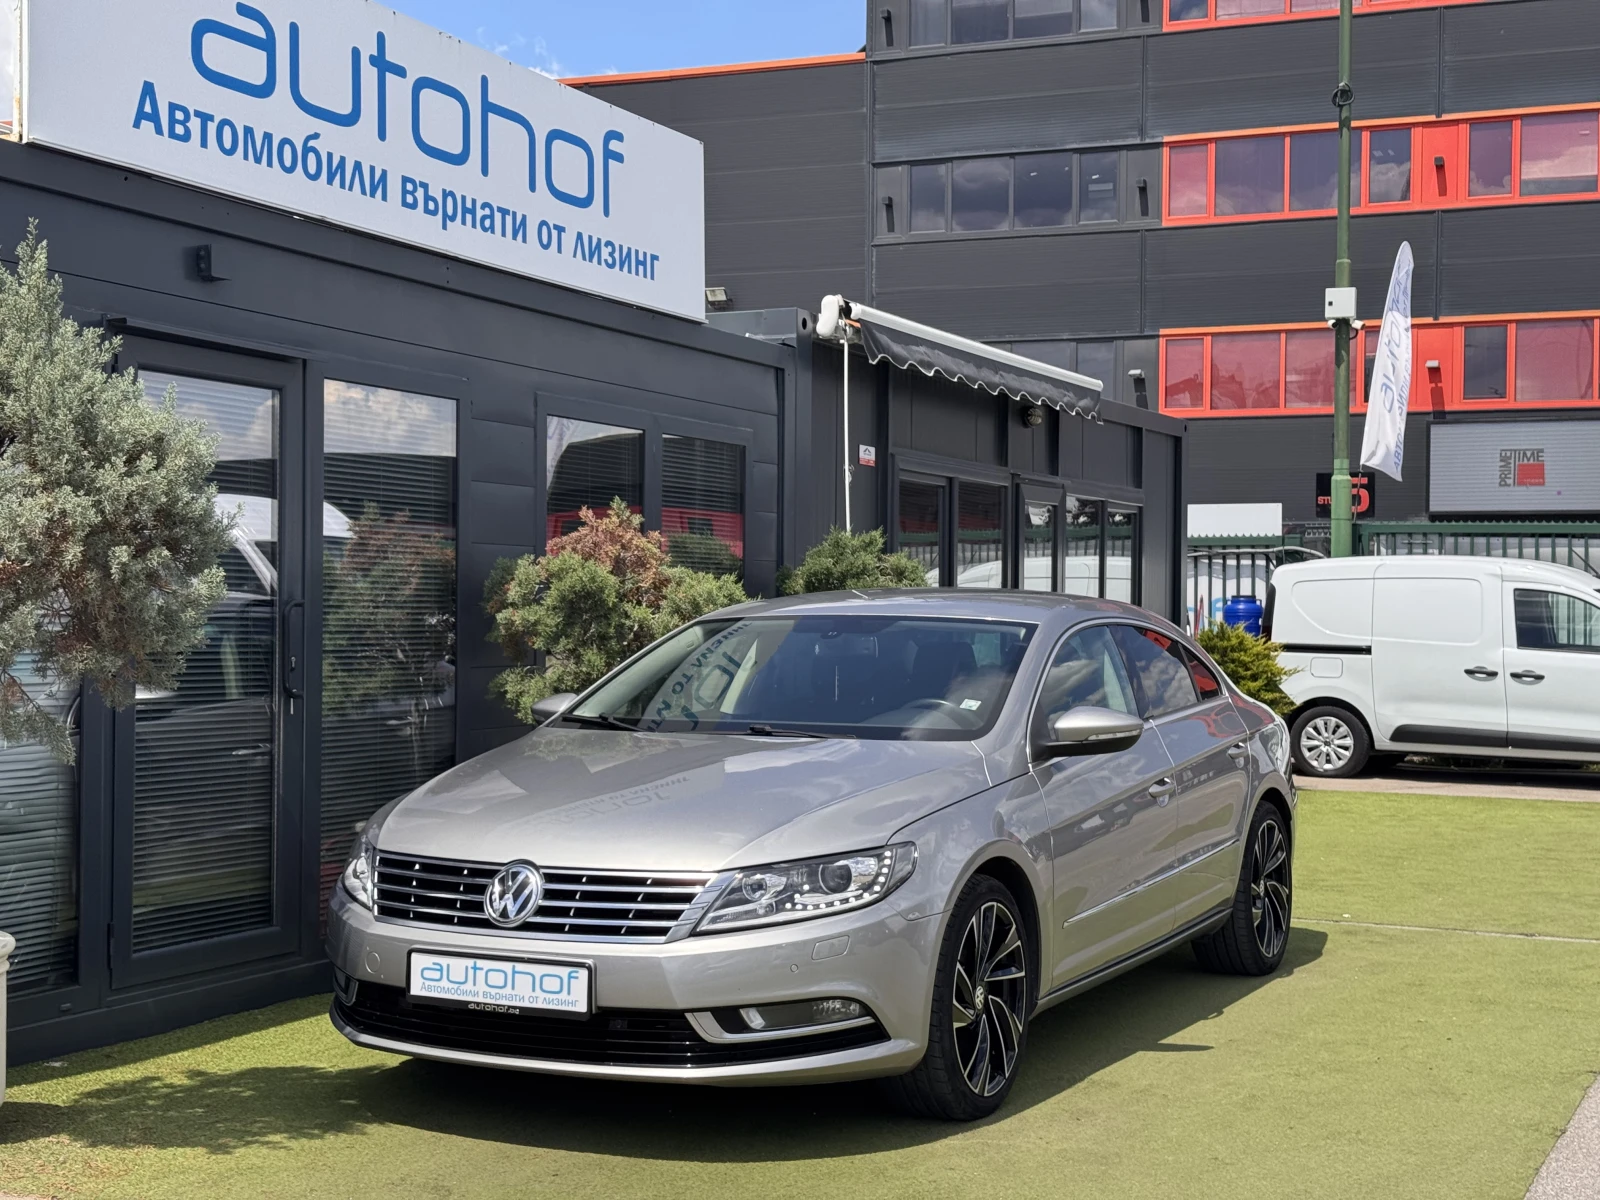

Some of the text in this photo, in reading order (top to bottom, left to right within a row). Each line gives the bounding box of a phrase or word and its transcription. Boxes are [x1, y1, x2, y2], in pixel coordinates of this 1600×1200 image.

[190, 1, 625, 218] autohof
[132, 80, 660, 281] Автомобили върнати от лизинг
[420, 960, 580, 996] autohof
[420, 981, 579, 1008] Автомобили върнати от лизинг
